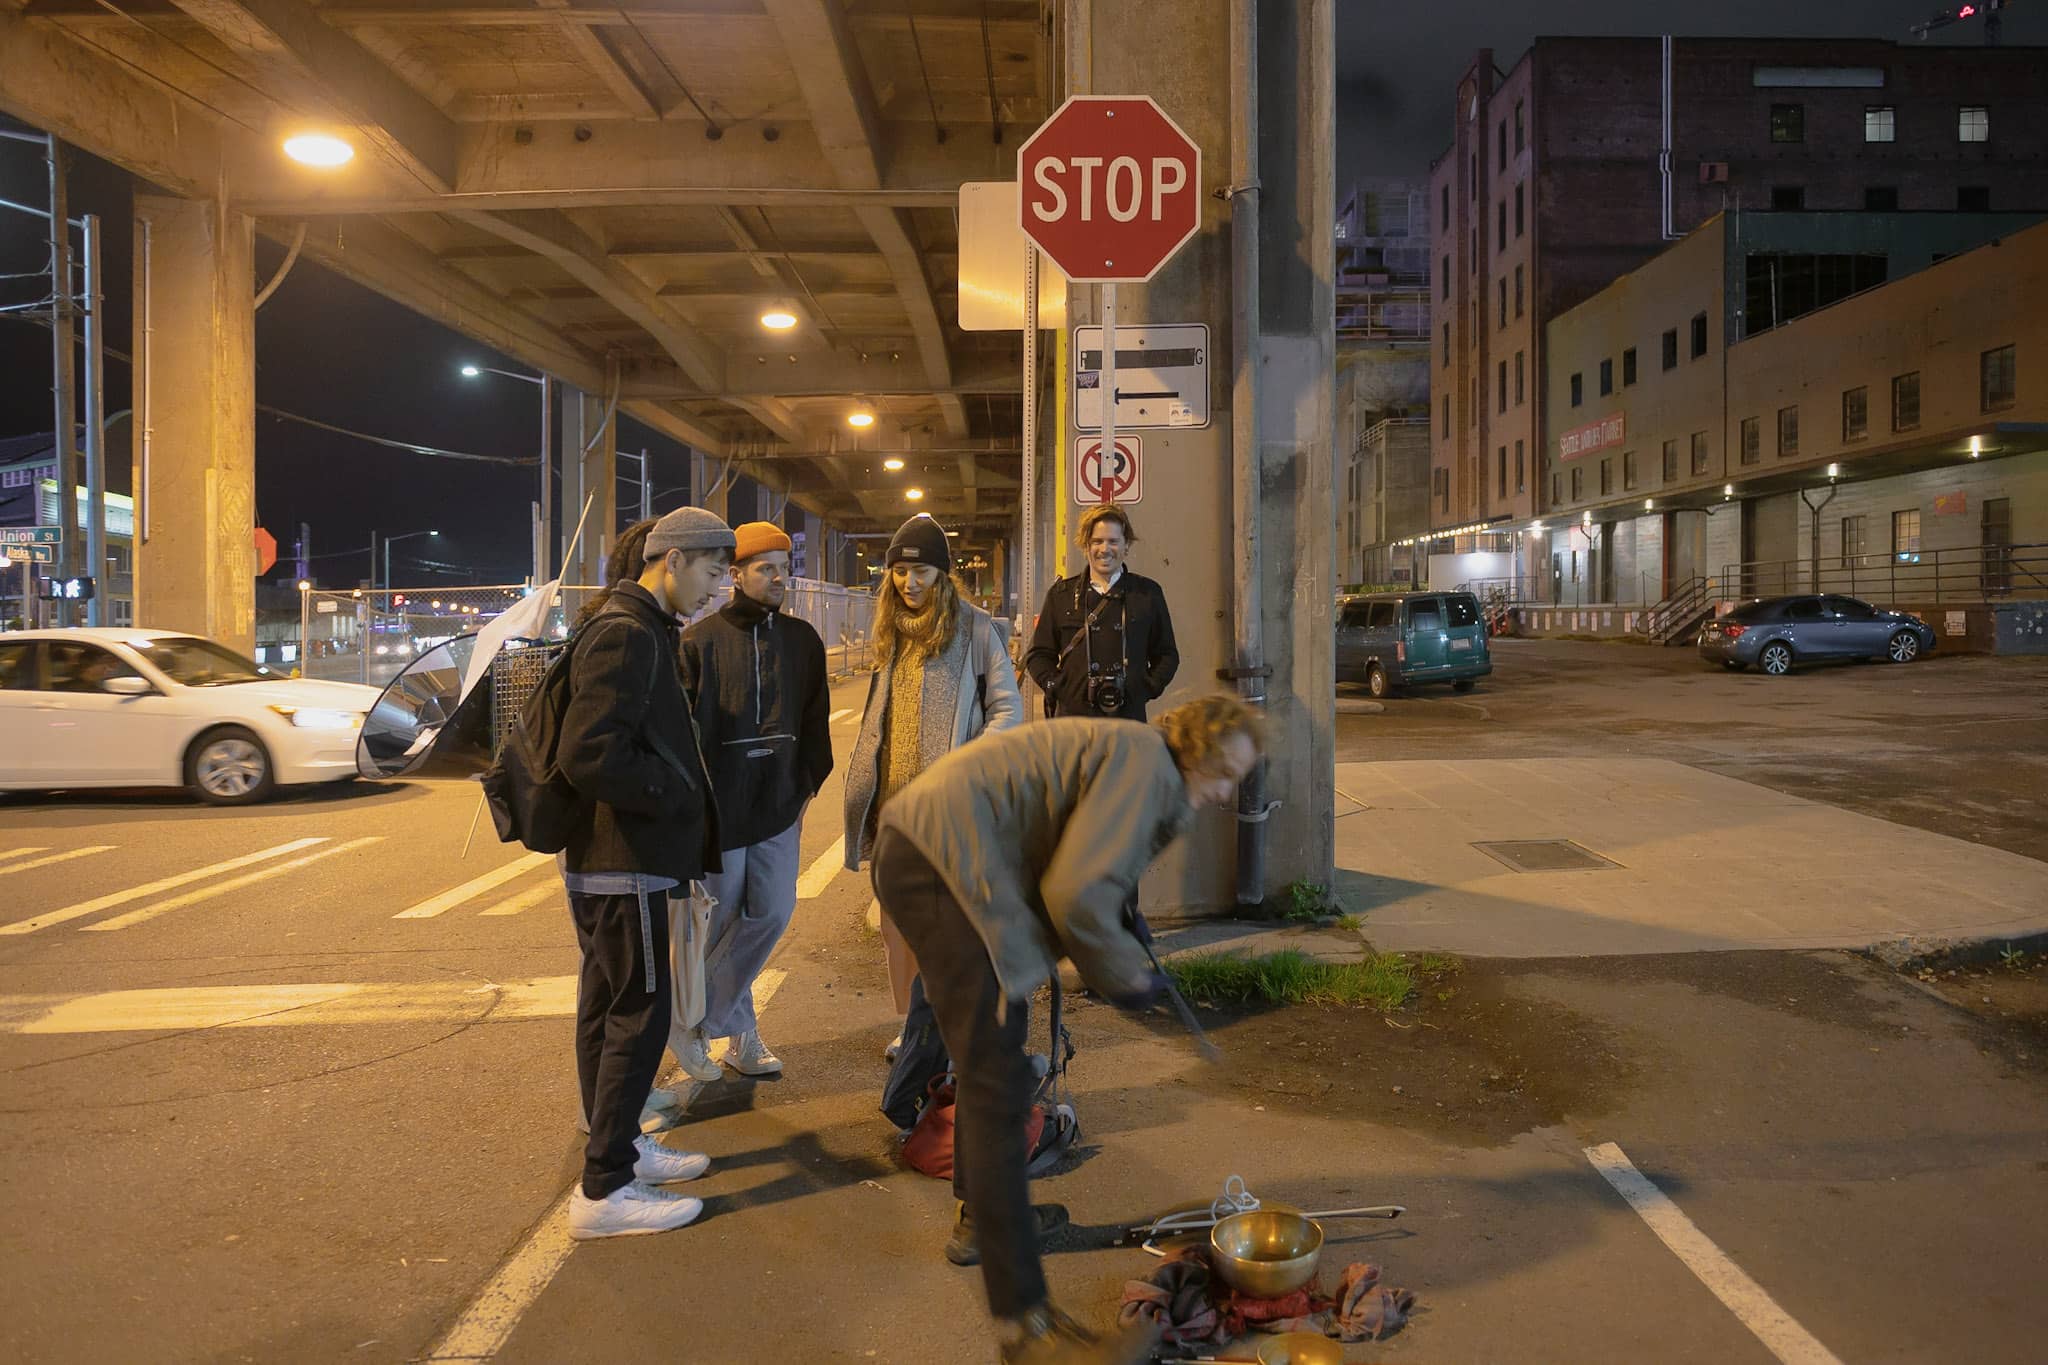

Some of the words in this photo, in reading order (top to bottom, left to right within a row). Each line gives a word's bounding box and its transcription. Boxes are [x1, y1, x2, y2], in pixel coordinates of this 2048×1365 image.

[1031, 155, 1187, 222] STOP
[0, 530, 36, 543] Union
[44, 532, 54, 541] St
